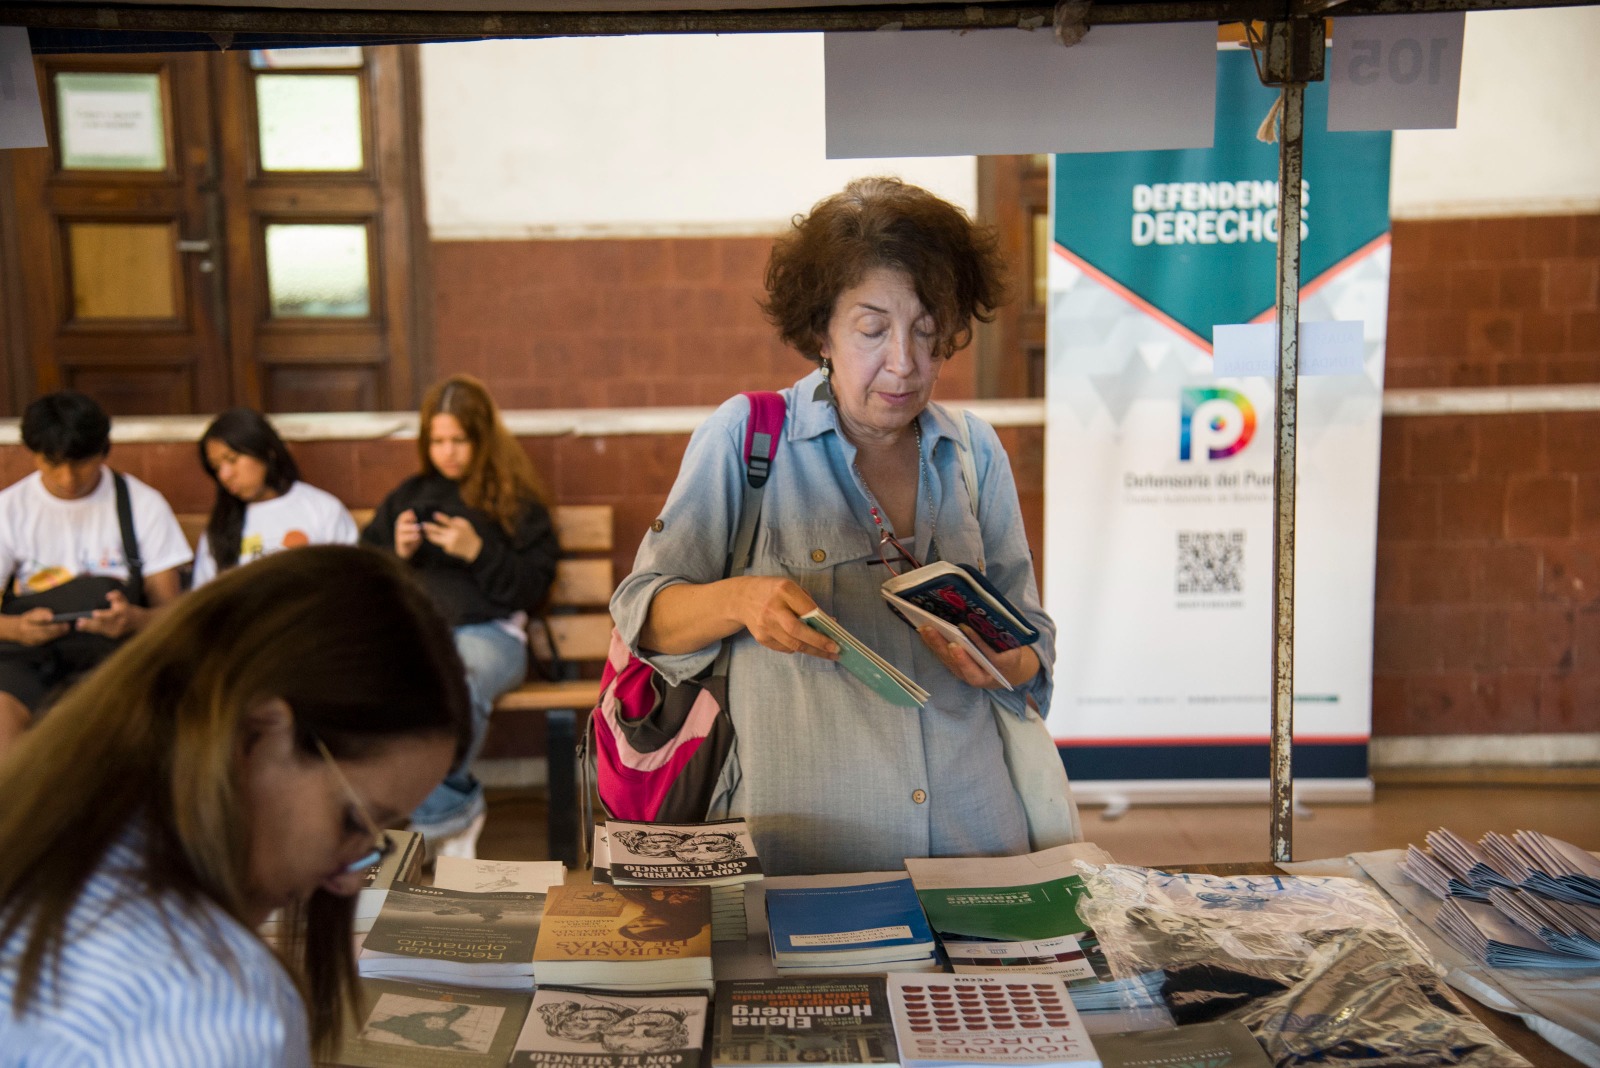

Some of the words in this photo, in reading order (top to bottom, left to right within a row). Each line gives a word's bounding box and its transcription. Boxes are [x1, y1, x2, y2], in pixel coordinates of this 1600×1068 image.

[1132, 179, 1310, 211] DEFENDEMS
[632, 868, 742, 878] CON-VIVIENDO
[396, 939, 507, 952] opinando
[394, 946, 503, 960] Recordar
[564, 947, 680, 956] SUBASTA
[732, 1004, 872, 1016] Holmberg
[732, 1017, 811, 1028] Elena
[915, 1035, 1078, 1046] TURCOS
[917, 1044, 1079, 1054] JÓVENES
[529, 1053, 612, 1065] SILENCIO
[619, 1056, 640, 1064] EL
[646, 1054, 683, 1064] CON
